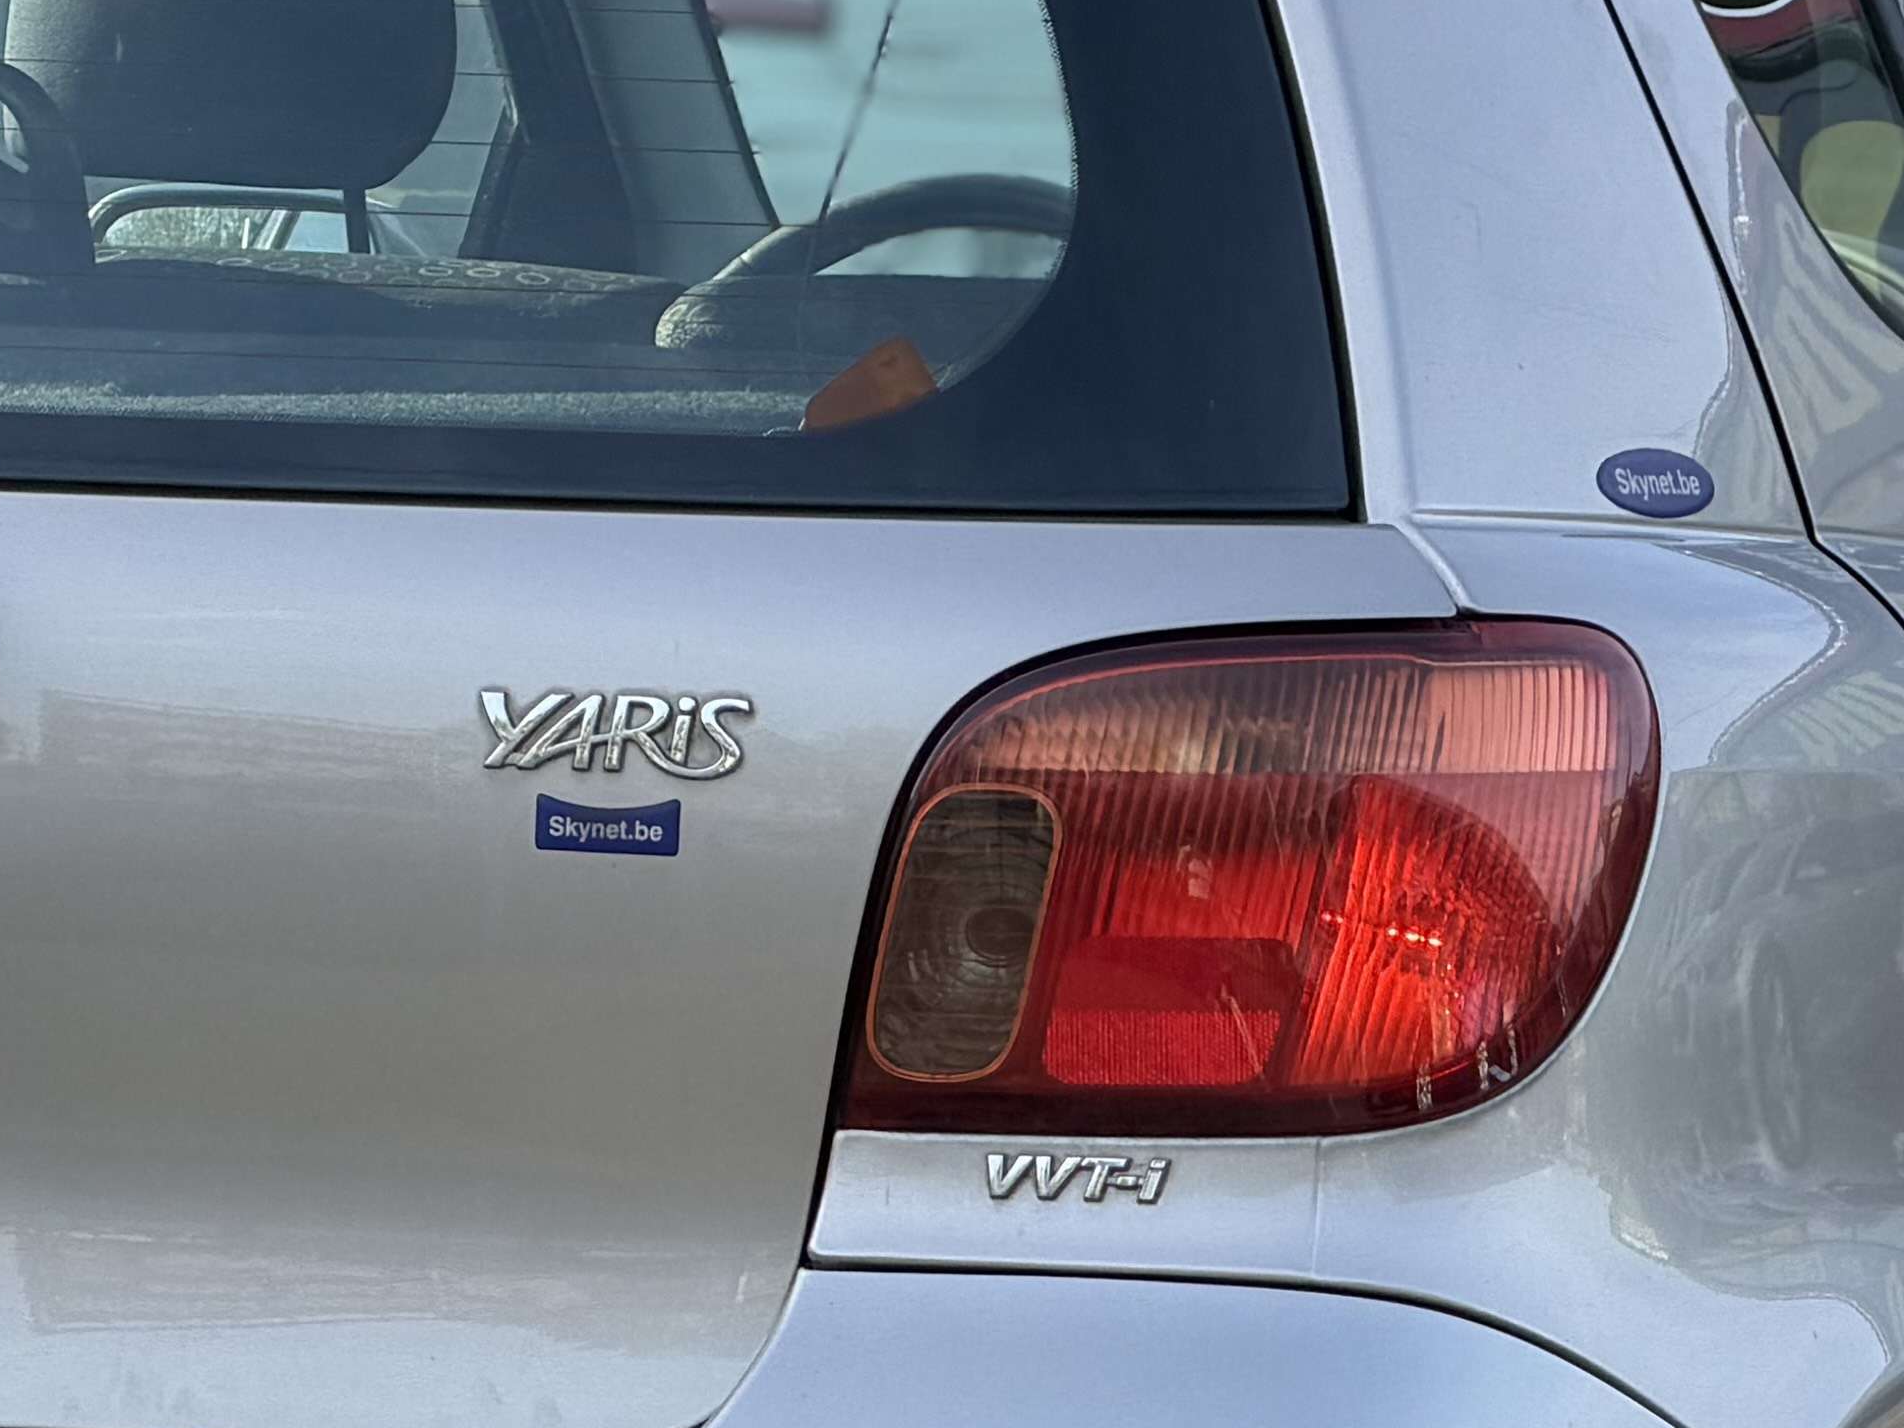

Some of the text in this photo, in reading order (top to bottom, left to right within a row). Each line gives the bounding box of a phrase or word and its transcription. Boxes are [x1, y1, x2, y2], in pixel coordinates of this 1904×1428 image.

[1614, 467, 1702, 501] Skynet.be
[548, 814, 664, 843] Skynet.be
[986, 1153, 1172, 1205] VVT-i
